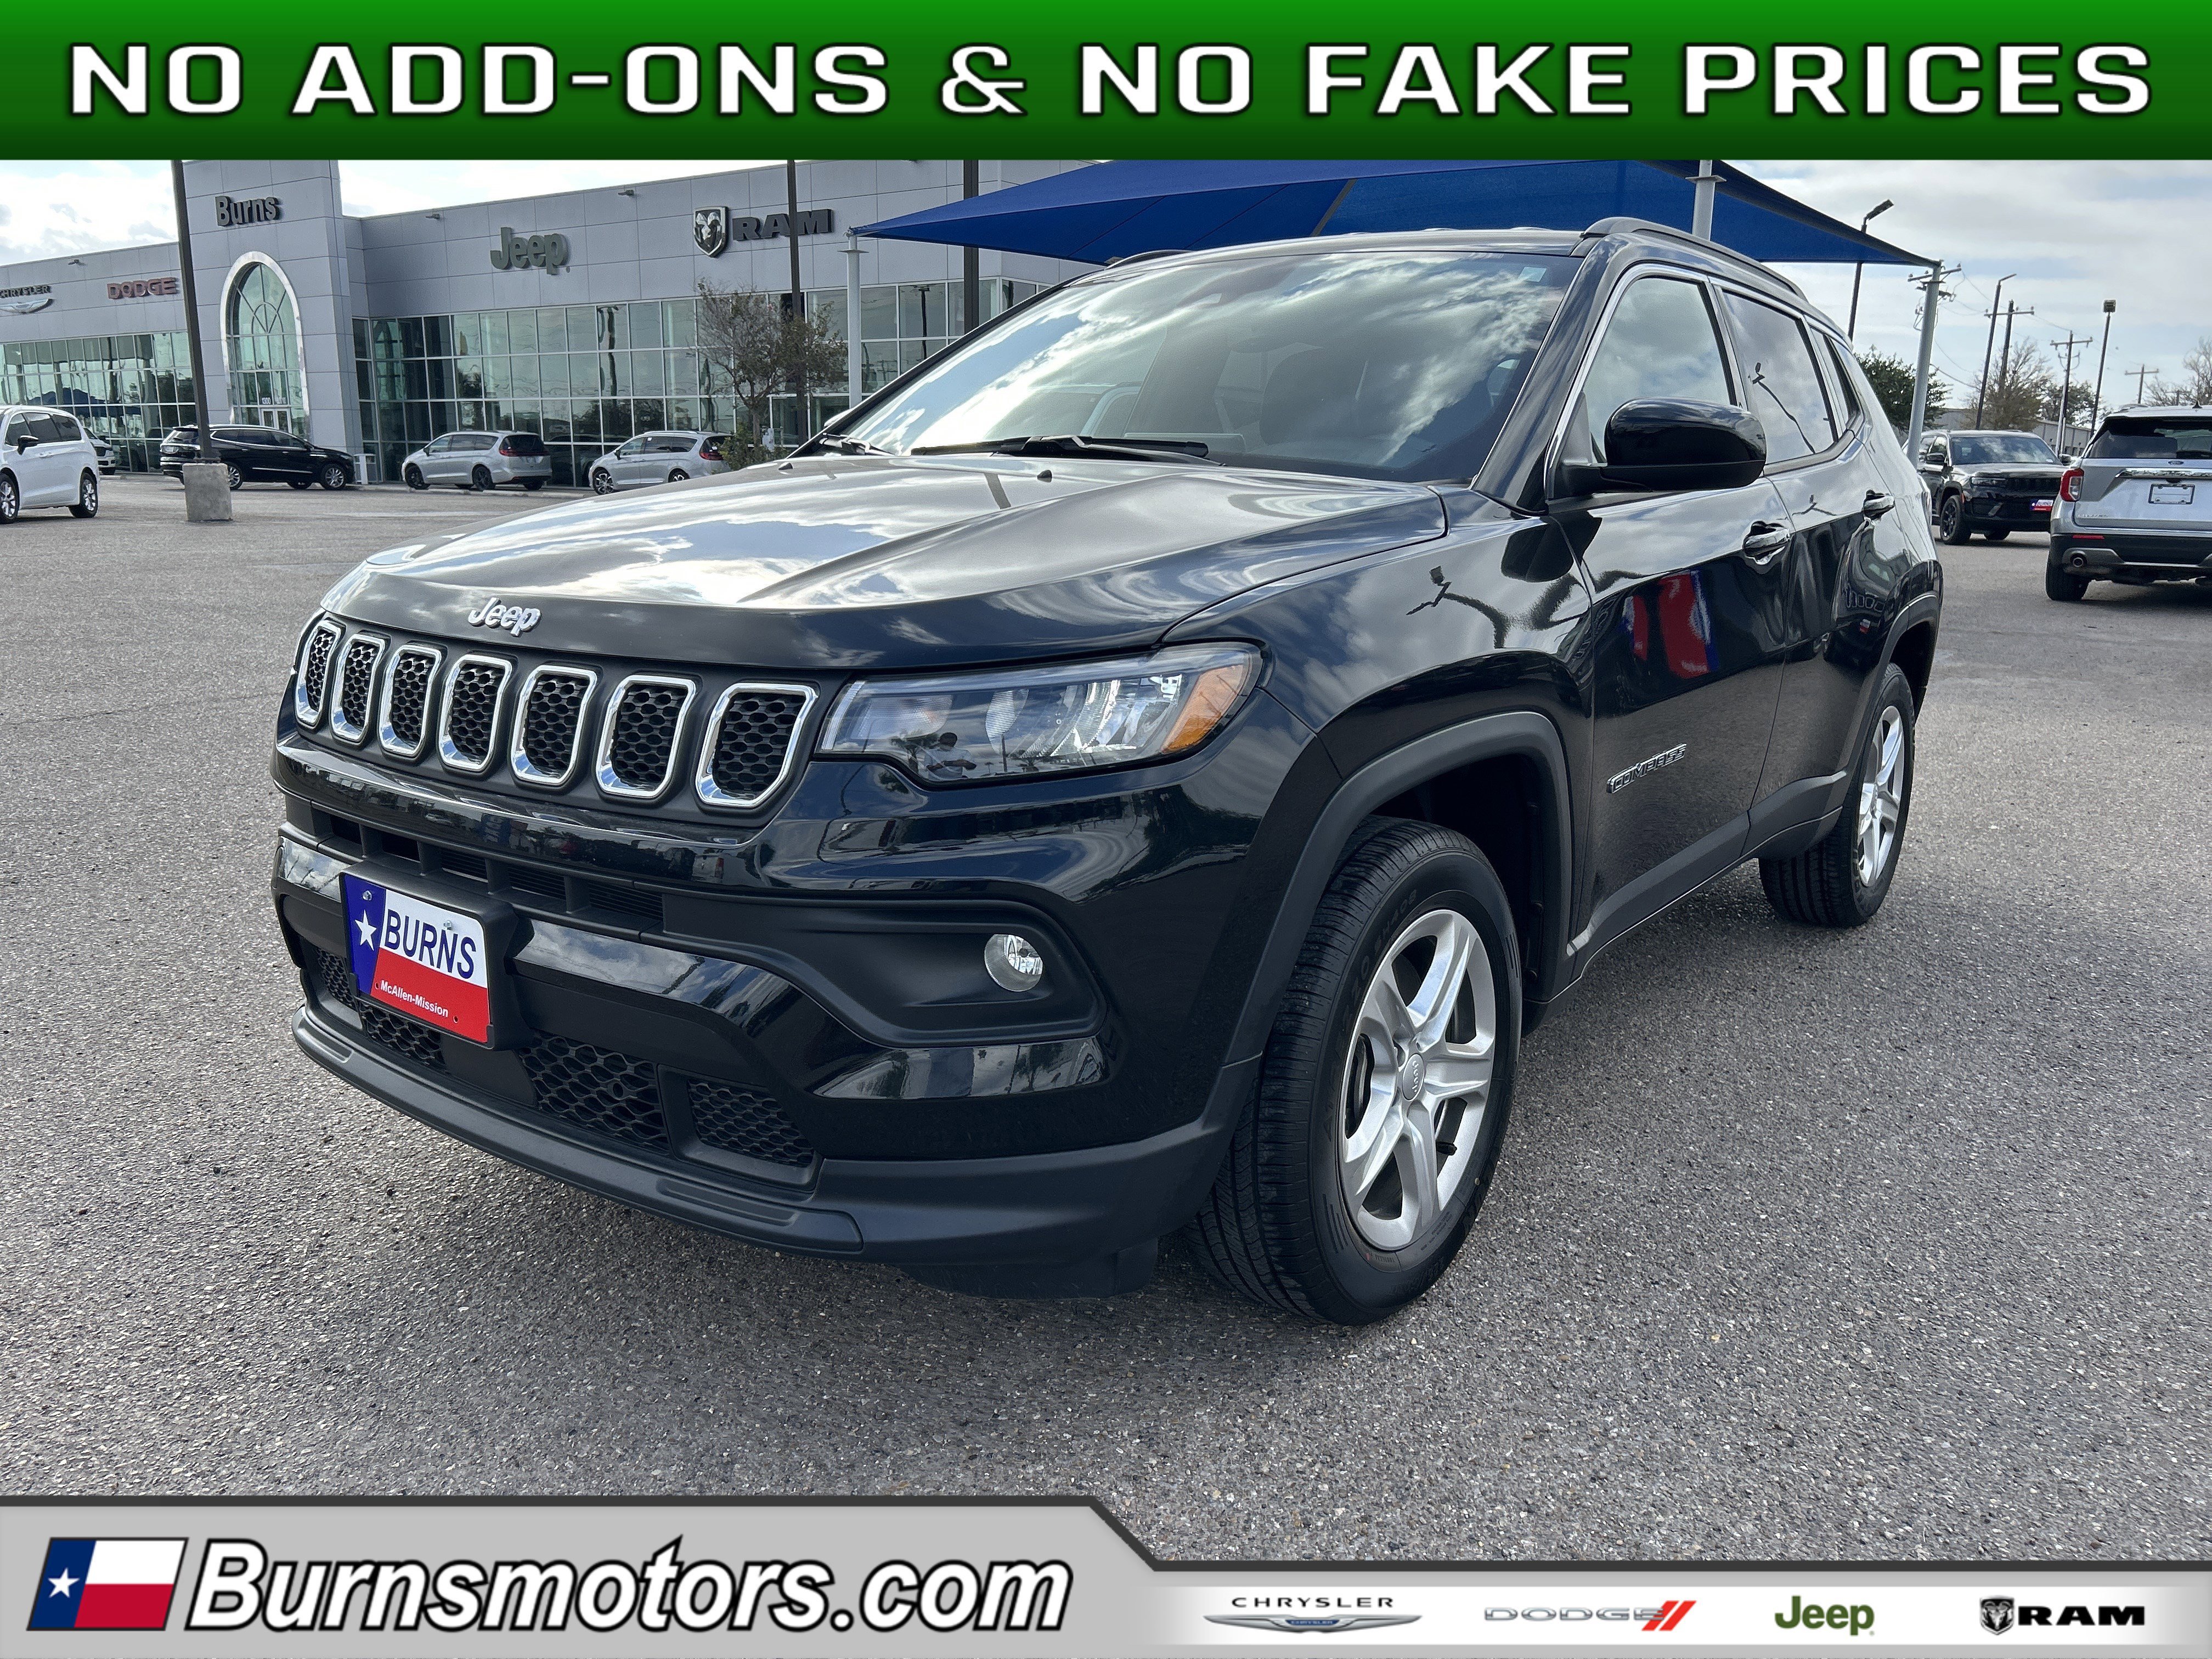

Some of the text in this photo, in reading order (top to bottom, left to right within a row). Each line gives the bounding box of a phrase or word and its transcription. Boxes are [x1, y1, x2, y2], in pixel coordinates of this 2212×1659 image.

[215, 196, 280, 227] Burns
[732, 207, 832, 241] RAM
[490, 227, 568, 275] Jeep
[107, 277, 178, 299] DODGE
[468, 597, 542, 636] Jeep
[1606, 743, 1687, 794] COMPASS
[384, 909, 477, 979] BURNS
[380, 979, 449, 1018] McAllen-Mission
